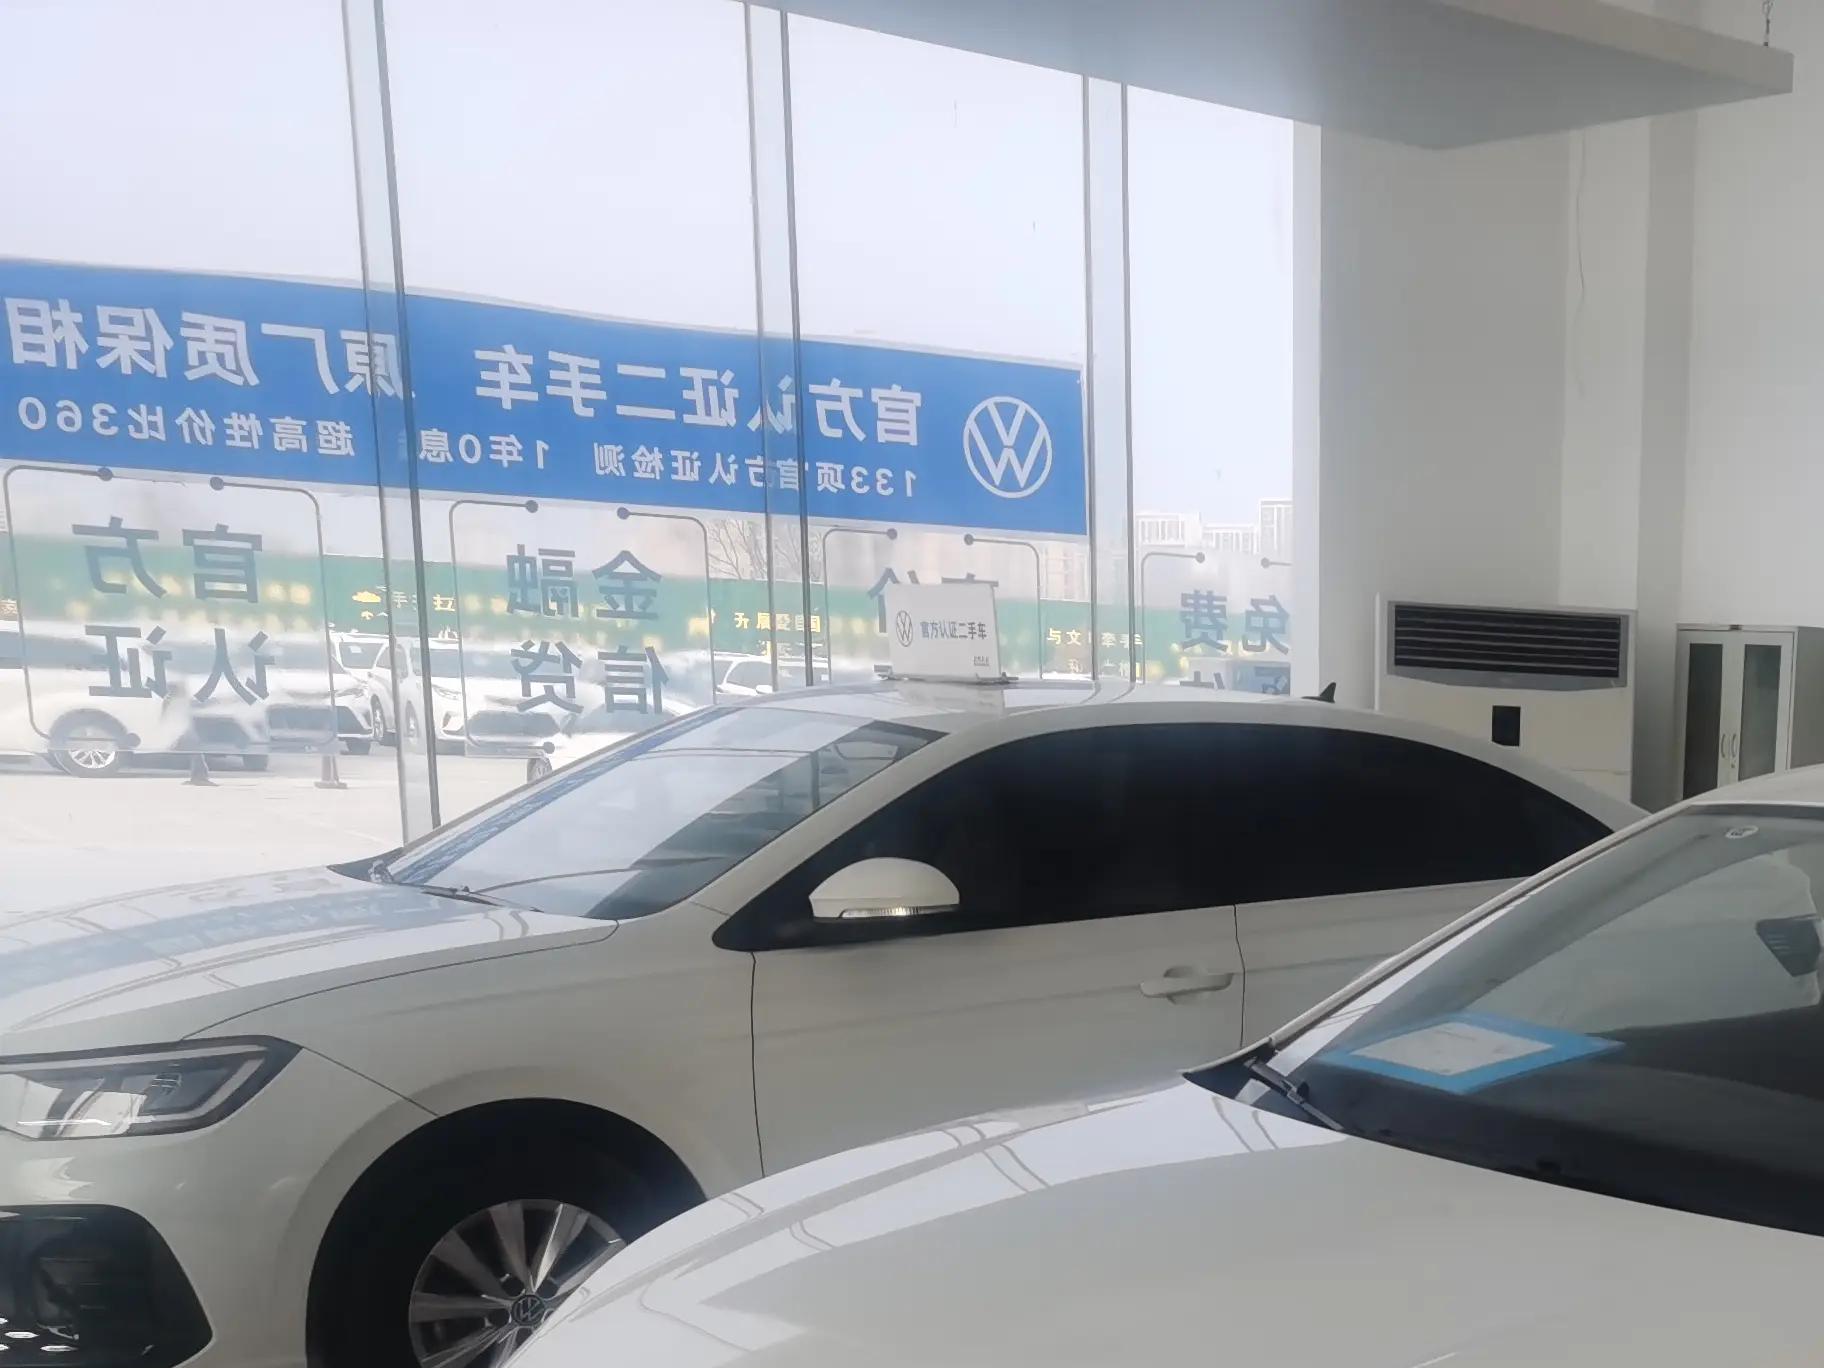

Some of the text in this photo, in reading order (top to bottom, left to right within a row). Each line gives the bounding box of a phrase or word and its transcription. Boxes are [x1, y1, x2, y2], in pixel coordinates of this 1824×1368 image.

[921, 621, 987, 640] 官方认证二手车
